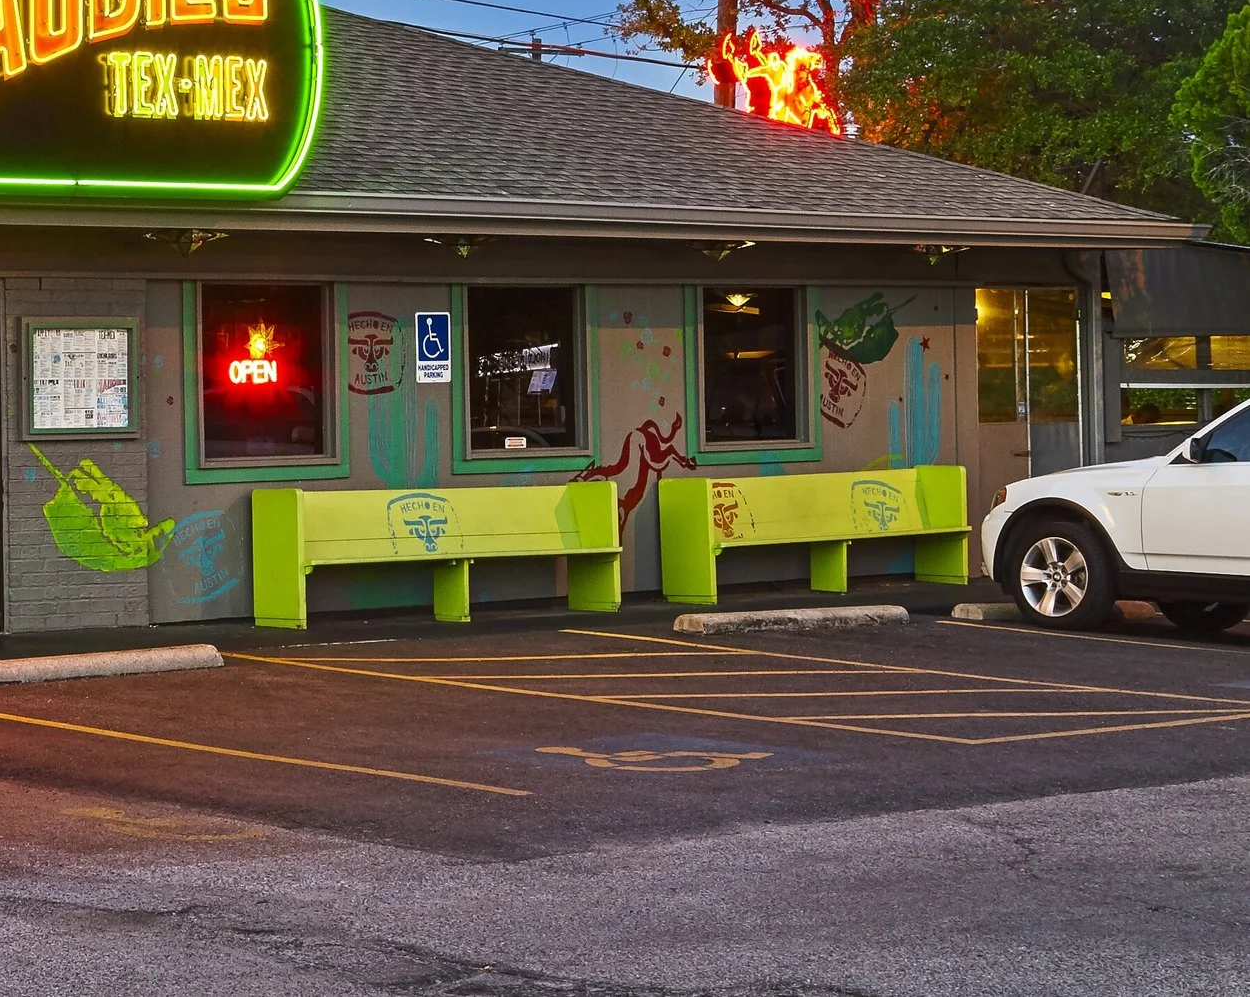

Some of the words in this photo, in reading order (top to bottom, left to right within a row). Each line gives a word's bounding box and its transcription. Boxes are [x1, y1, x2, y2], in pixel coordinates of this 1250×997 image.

[348, 319, 379, 332] HECHO
[381, 325, 393, 333] EN
[229, 359, 277, 384] OPEN
[418, 364, 449, 372] HANDICAPPED
[355, 372, 388, 385] AUSTIN
[423, 371, 444, 379] PARKING
[851, 368, 861, 382] EN
[823, 397, 844, 417] USTIN
[400, 501, 430, 513] HECHO
[432, 503, 445, 513] EN
